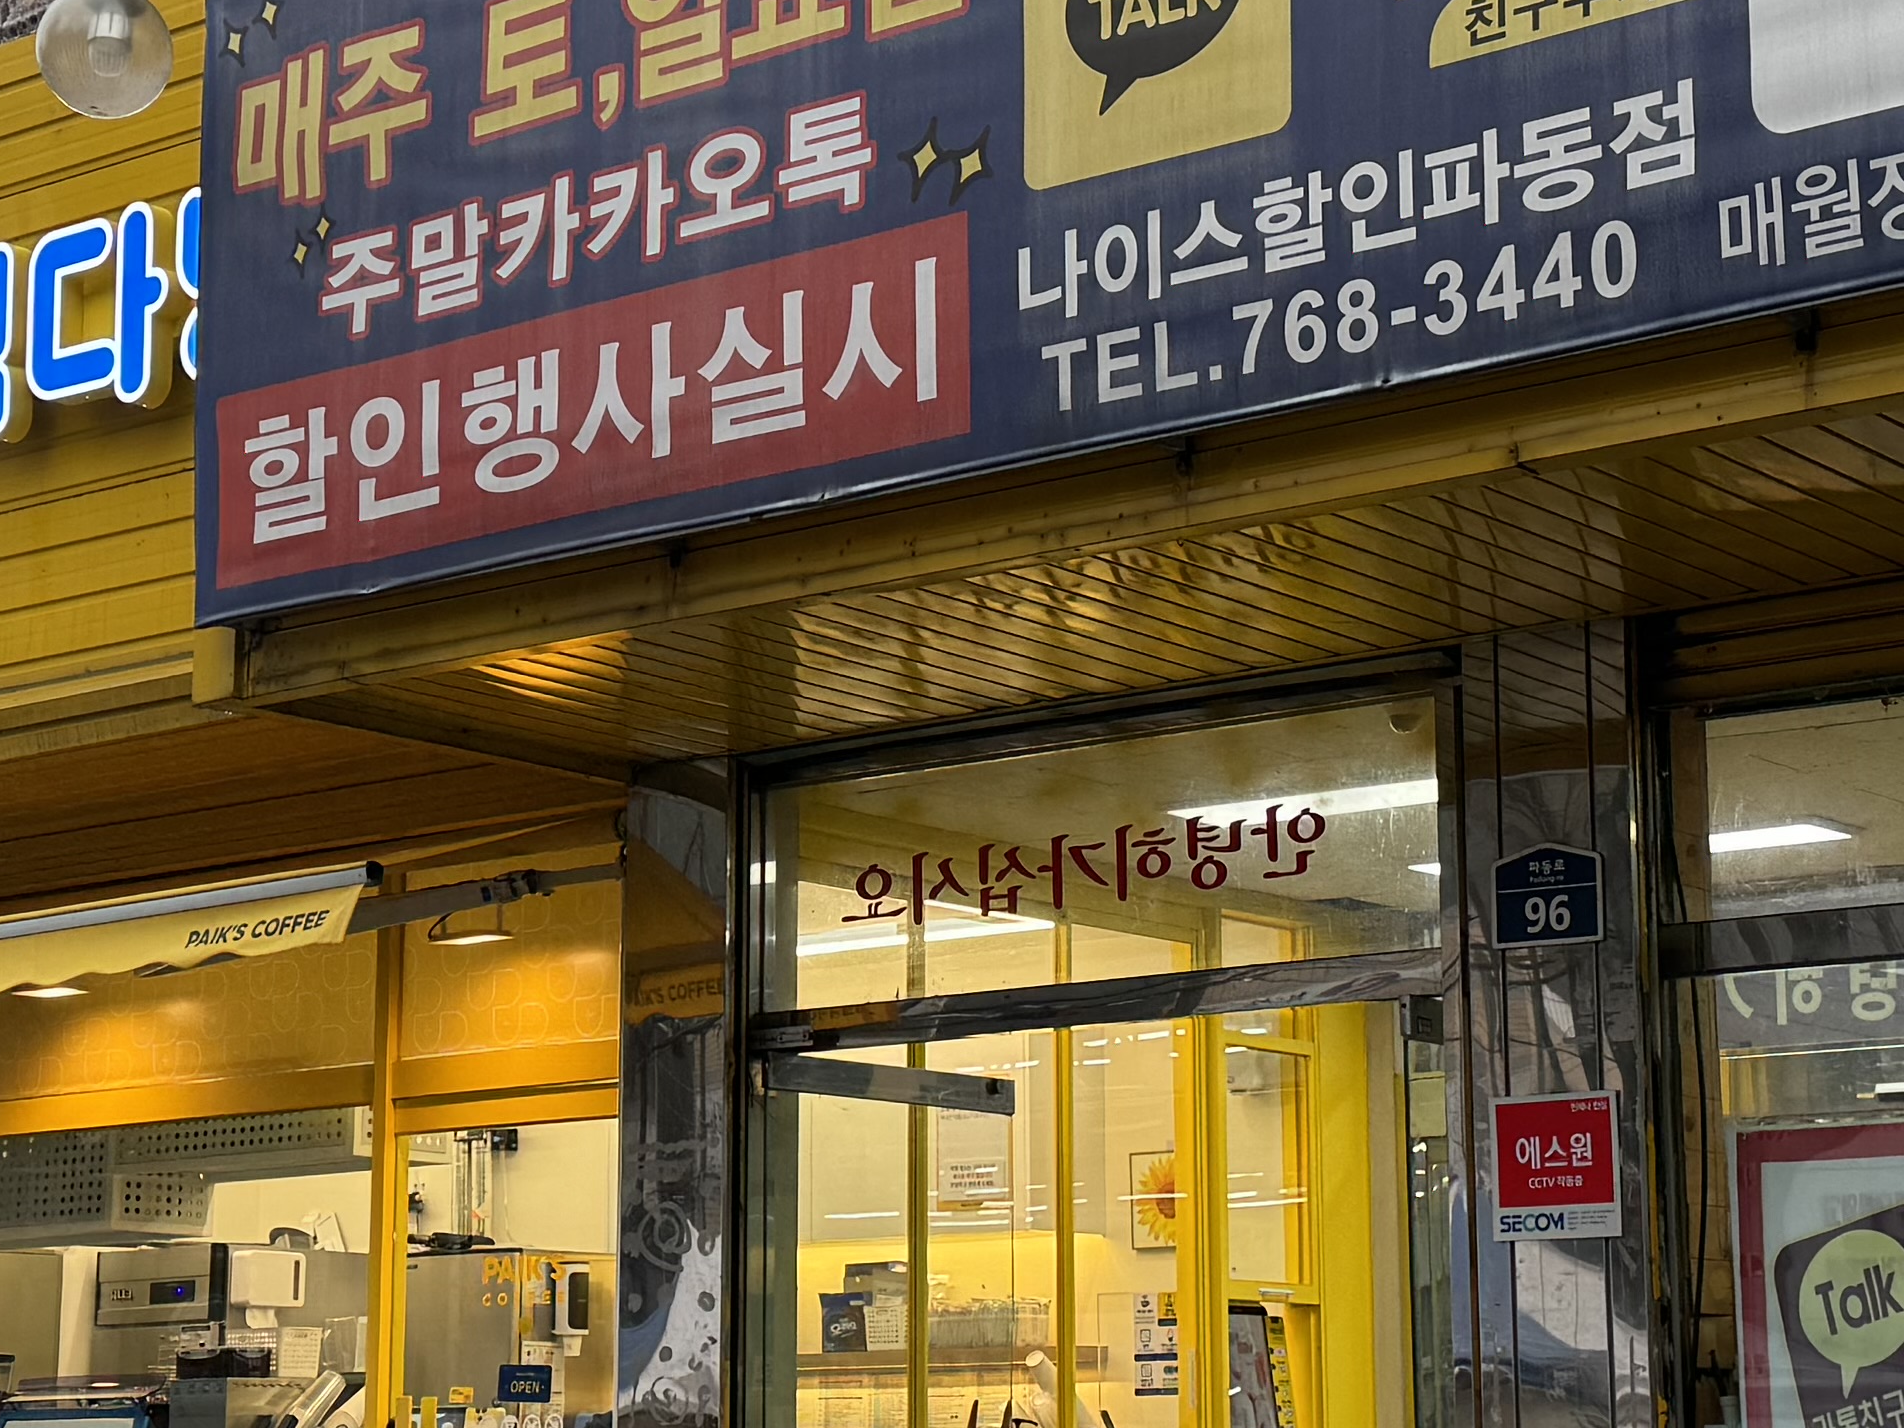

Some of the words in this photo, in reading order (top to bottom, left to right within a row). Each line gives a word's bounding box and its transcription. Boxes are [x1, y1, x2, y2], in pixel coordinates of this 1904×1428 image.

[234, 22, 431, 208] 매주
[318, 92, 878, 340] 주말카카오톡
[1016, 77, 1696, 319] 나이스할인파동점
[1040, 219, 1639, 412] TEL.768-3440
[245, 257, 939, 546] 할인행사실시
[1528, 859, 1565, 874] 파동로
[185, 921, 248, 949] PAIK'S
[249, 908, 331, 940] COFFEE
[1524, 894, 1571, 934] 96
[1515, 1132, 1593, 1170] 에스원
[1528, 1177, 1555, 1189] CCTV
[1500, 1212, 1565, 1233] SECOM
[1814, 1263, 1904, 1338] Talk
[510, 1381, 540, 1394] OPEN
